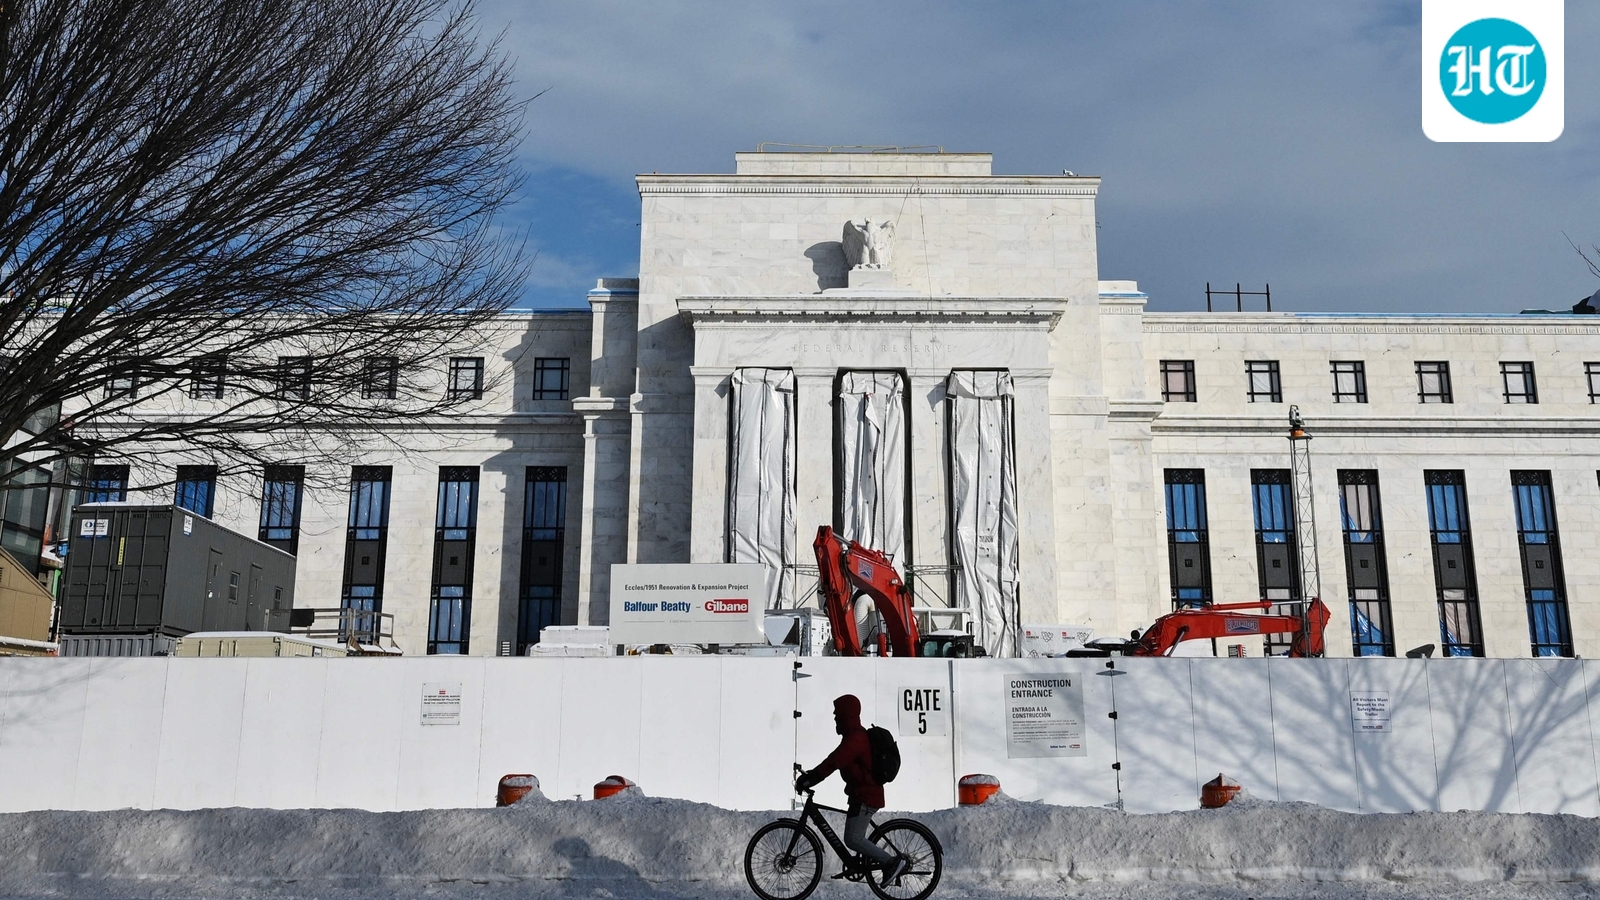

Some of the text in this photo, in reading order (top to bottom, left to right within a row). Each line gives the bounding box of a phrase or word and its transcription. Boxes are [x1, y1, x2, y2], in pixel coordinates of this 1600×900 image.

[793, 344, 952, 353] FEDERAL RESERVE
[624, 601, 691, 613] Balfour Beatty
[704, 600, 748, 612] Gilbane
[1011, 679, 1071, 688] CONSTRUCTION
[1011, 689, 1053, 698] ENTRANCE
[903, 689, 941, 711] GATE
[918, 712, 927, 734] 5
